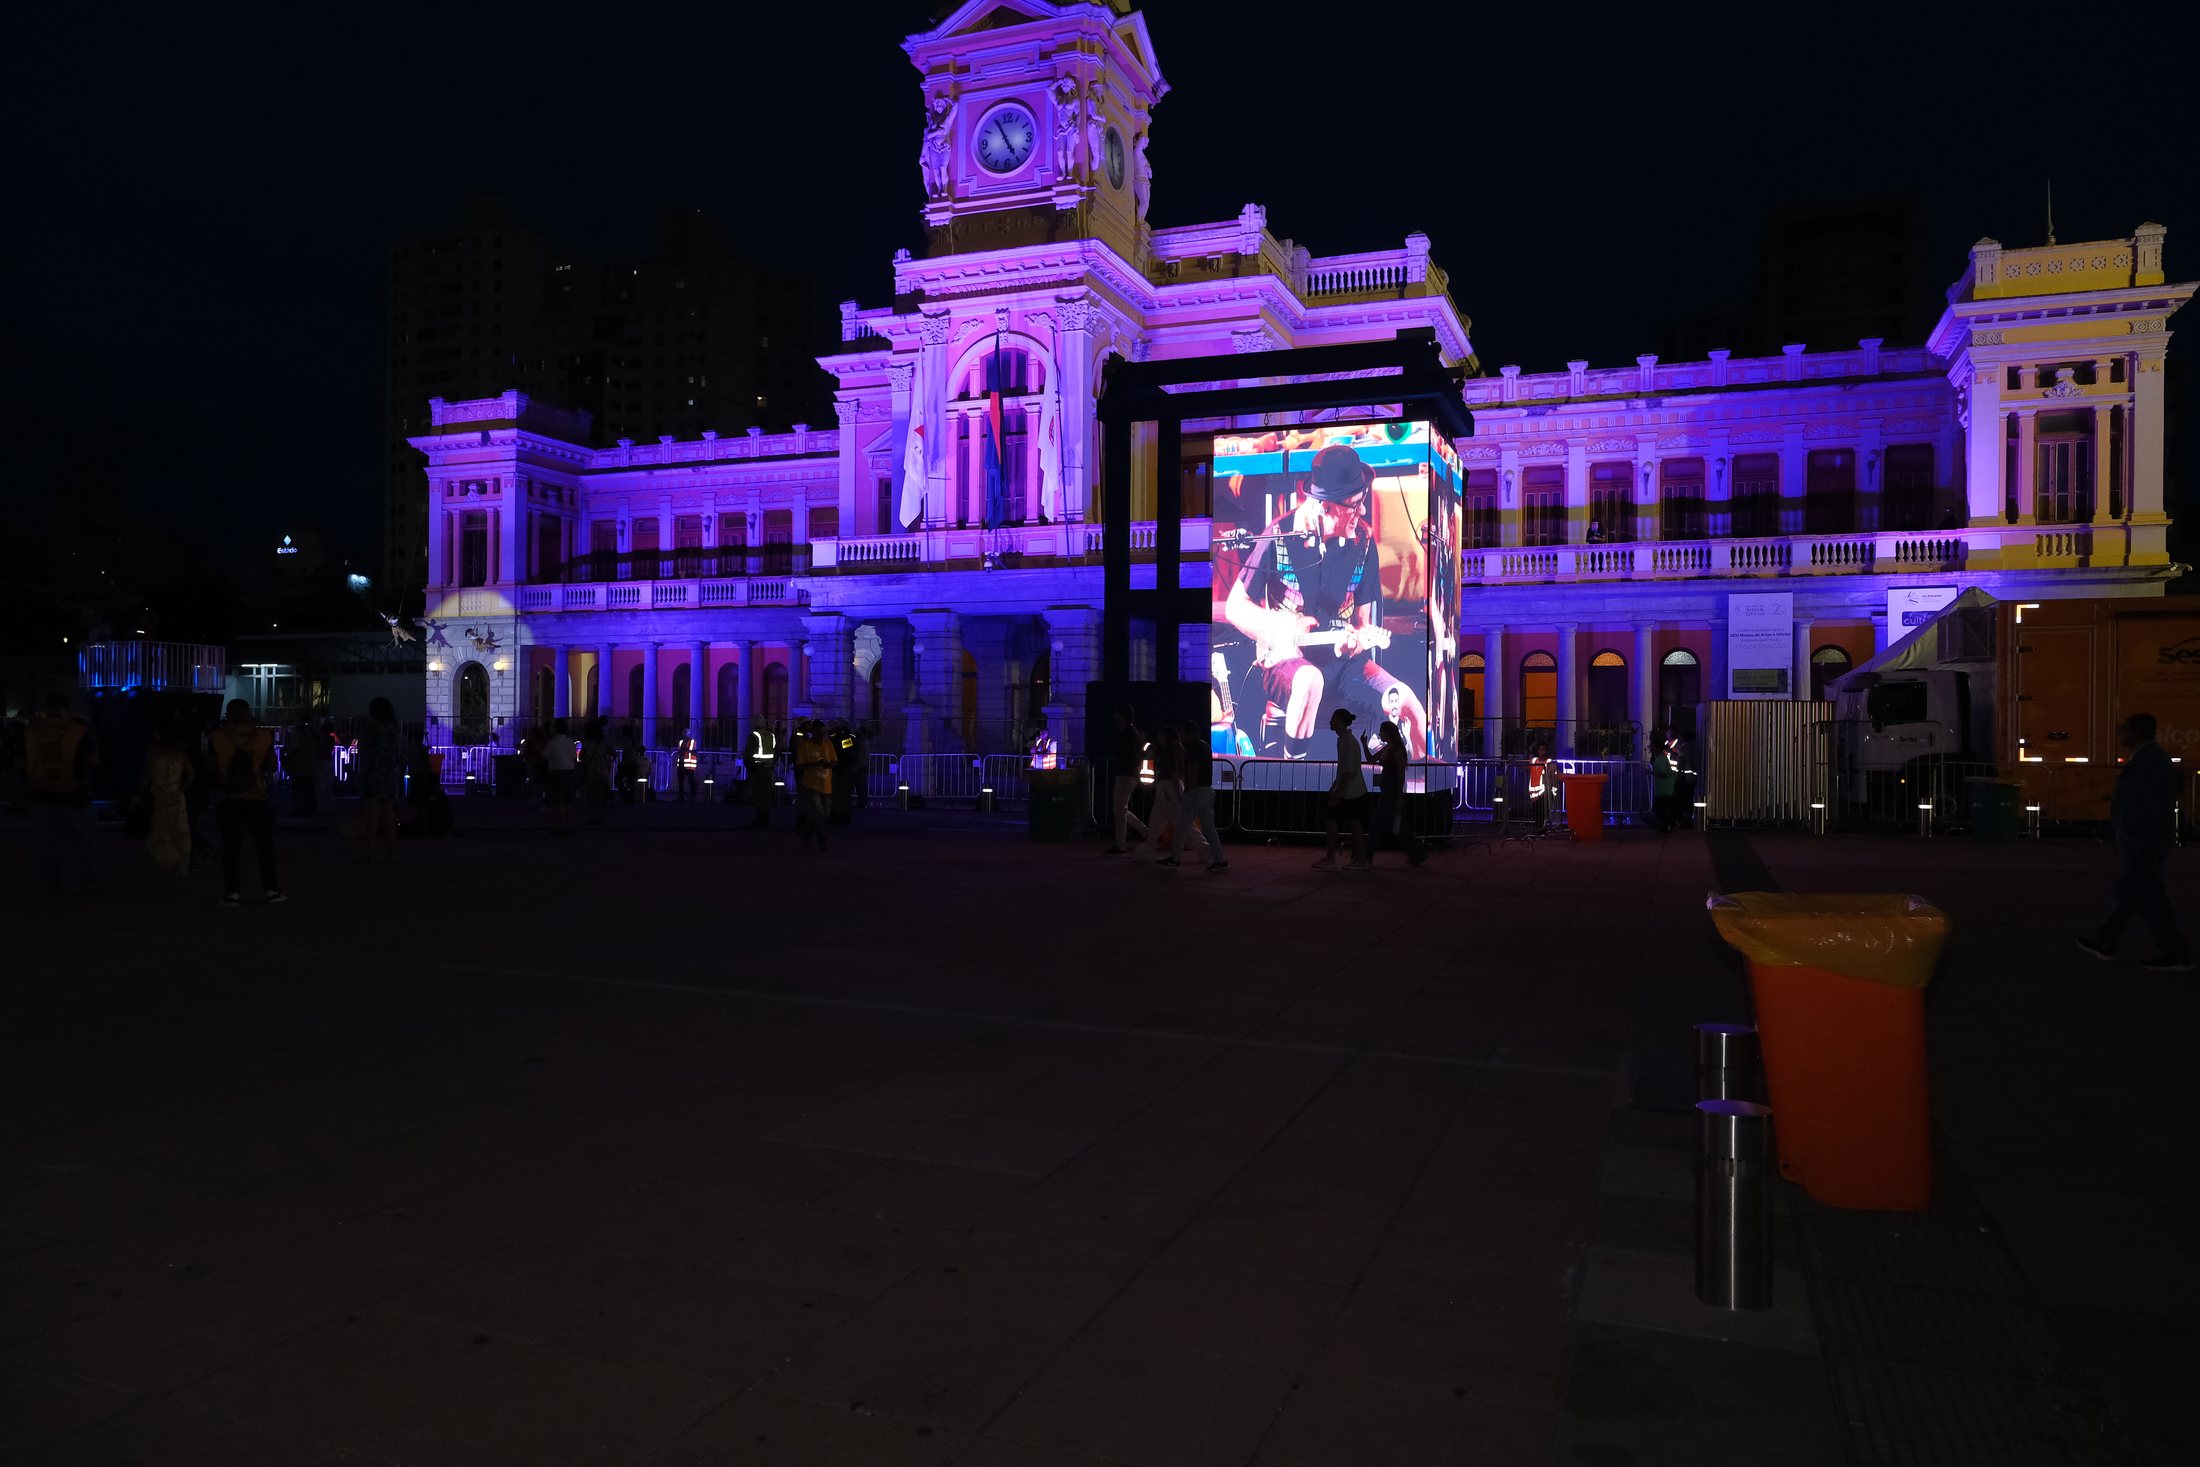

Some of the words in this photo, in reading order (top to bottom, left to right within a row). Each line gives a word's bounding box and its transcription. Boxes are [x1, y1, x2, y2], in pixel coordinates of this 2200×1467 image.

[1003, 111, 1014, 124] 12
[1025, 131, 1032, 142] 3
[981, 139, 988, 150] 9
[1004, 158, 1011, 168] 6
